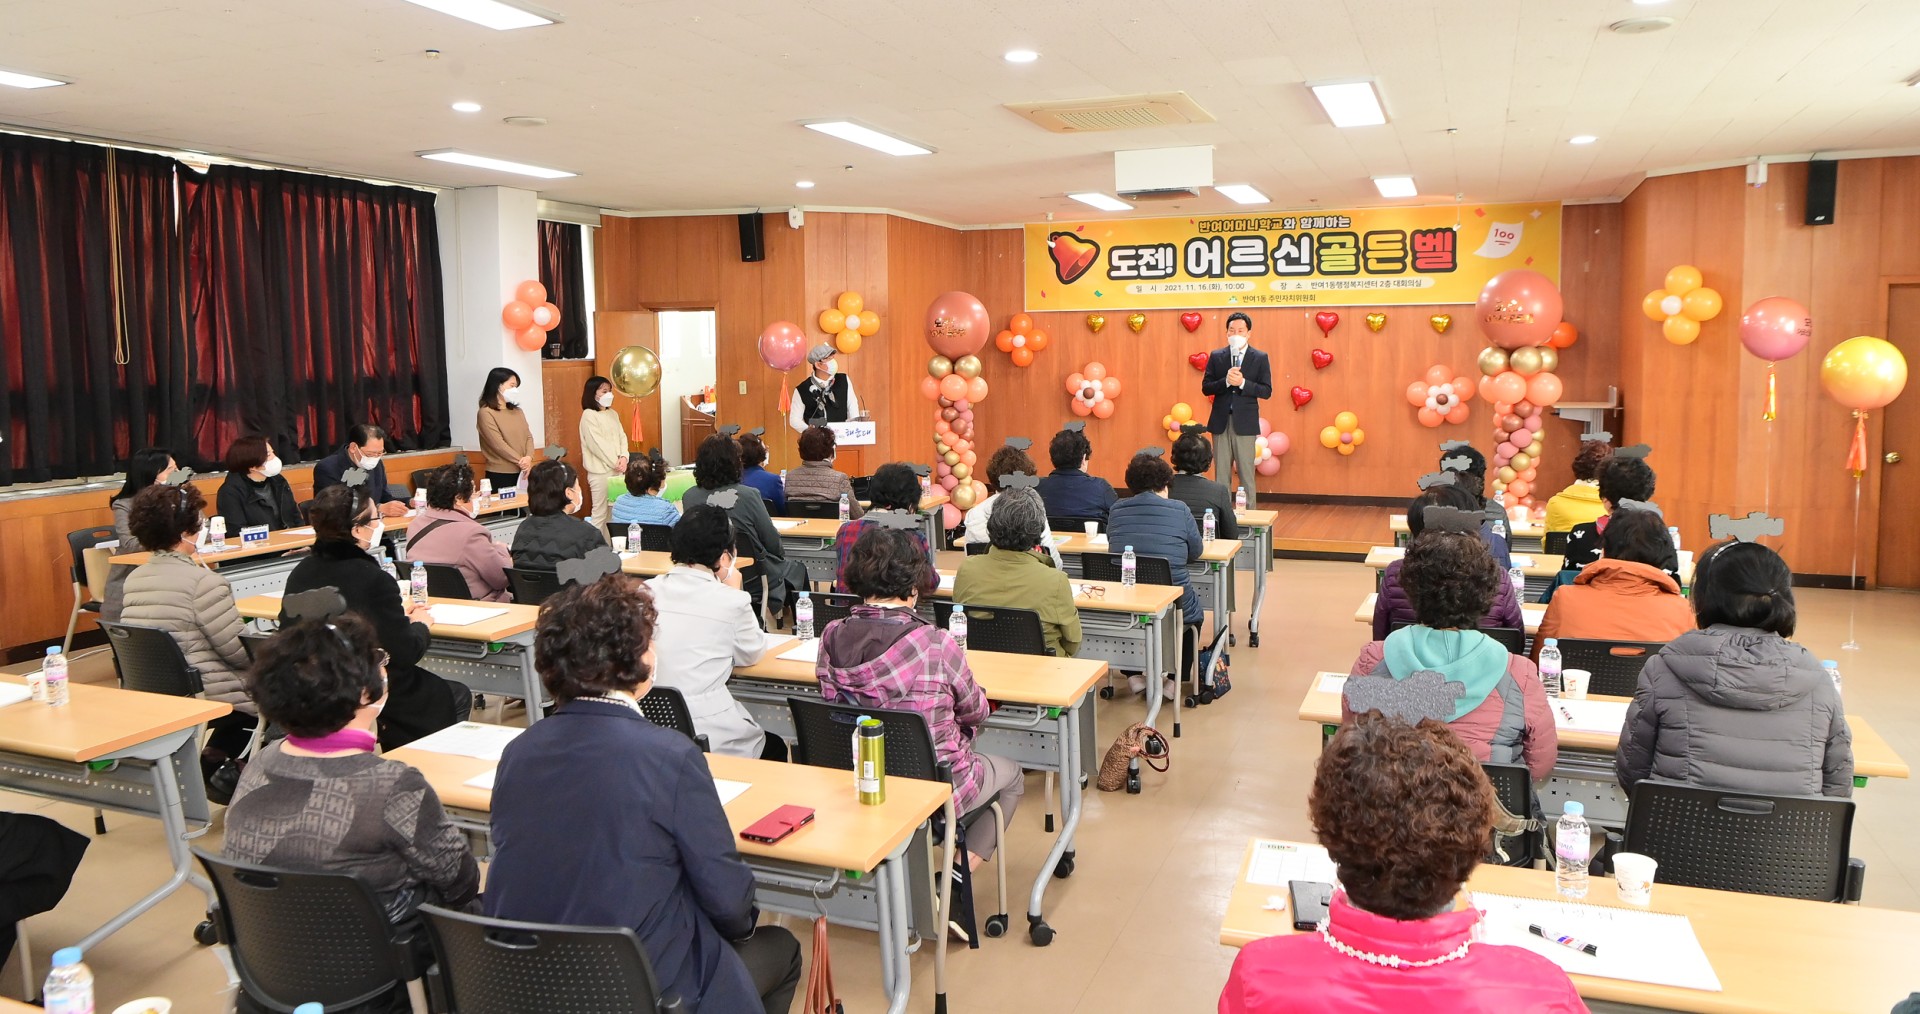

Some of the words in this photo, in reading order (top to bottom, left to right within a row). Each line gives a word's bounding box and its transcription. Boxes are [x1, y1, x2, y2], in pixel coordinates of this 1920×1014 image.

[1199, 218, 1296, 233] 반여어머니학교와
[1300, 215, 1351, 229] 함께하는
[1494, 228, 1515, 240] 100
[1107, 243, 1177, 280] 도전!
[1268, 293, 1316, 303] 주민자치위원회
